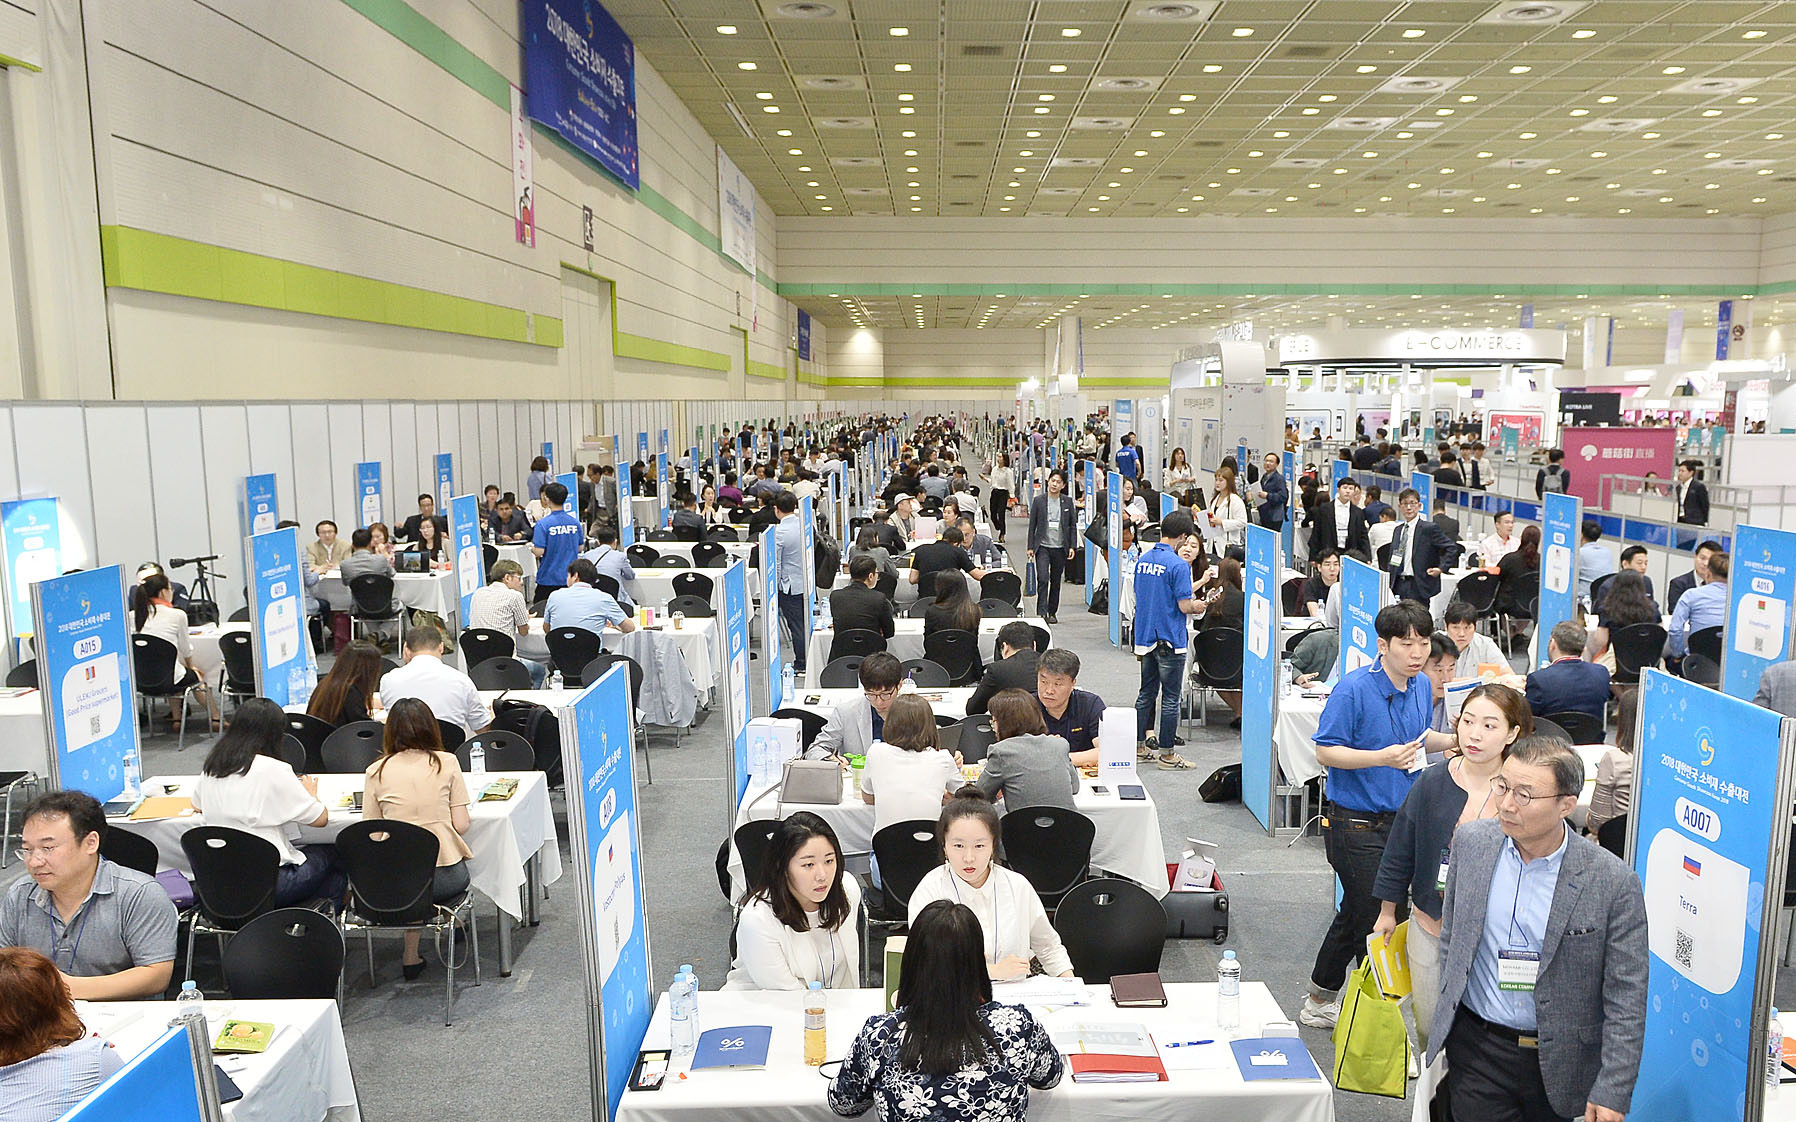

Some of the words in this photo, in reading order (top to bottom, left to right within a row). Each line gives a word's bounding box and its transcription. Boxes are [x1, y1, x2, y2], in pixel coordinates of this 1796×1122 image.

[549, 525, 578, 536] STAFF
[1136, 562, 1167, 577] STAFF
[80, 639, 97, 655] A015
[1660, 753, 1675, 769] 2018
[1675, 760, 1699, 782] 대한민국
[1699, 771, 1718, 791] 소비재
[1719, 780, 1749, 804] 수출대전
[1683, 805, 1711, 833] A007
[1679, 895, 1698, 915] Terra
